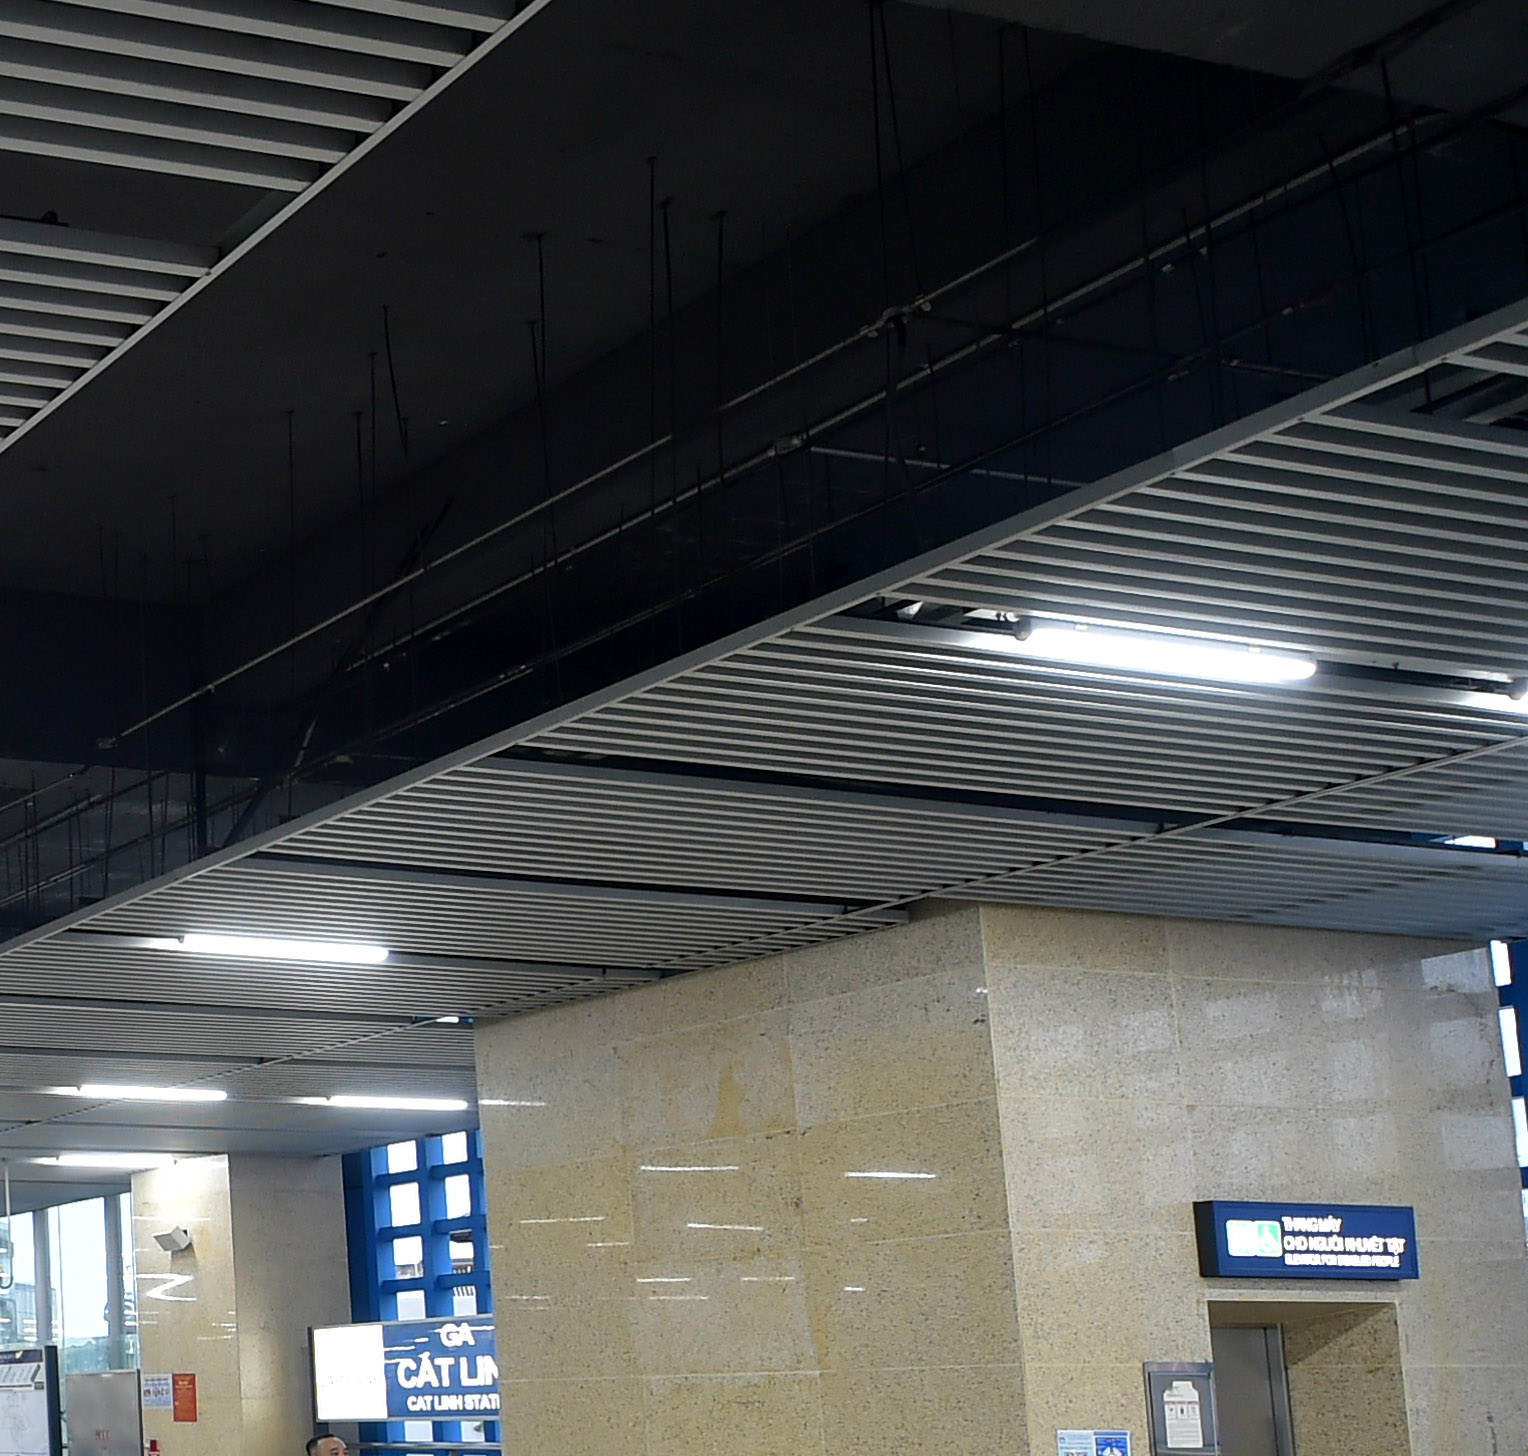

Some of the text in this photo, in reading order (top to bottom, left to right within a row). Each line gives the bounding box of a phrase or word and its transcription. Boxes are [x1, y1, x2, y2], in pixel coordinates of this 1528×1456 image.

[439, 1322, 476, 1347] GA
[406, 1394, 433, 1411] CAT
[434, 1394, 463, 1411] LINH
